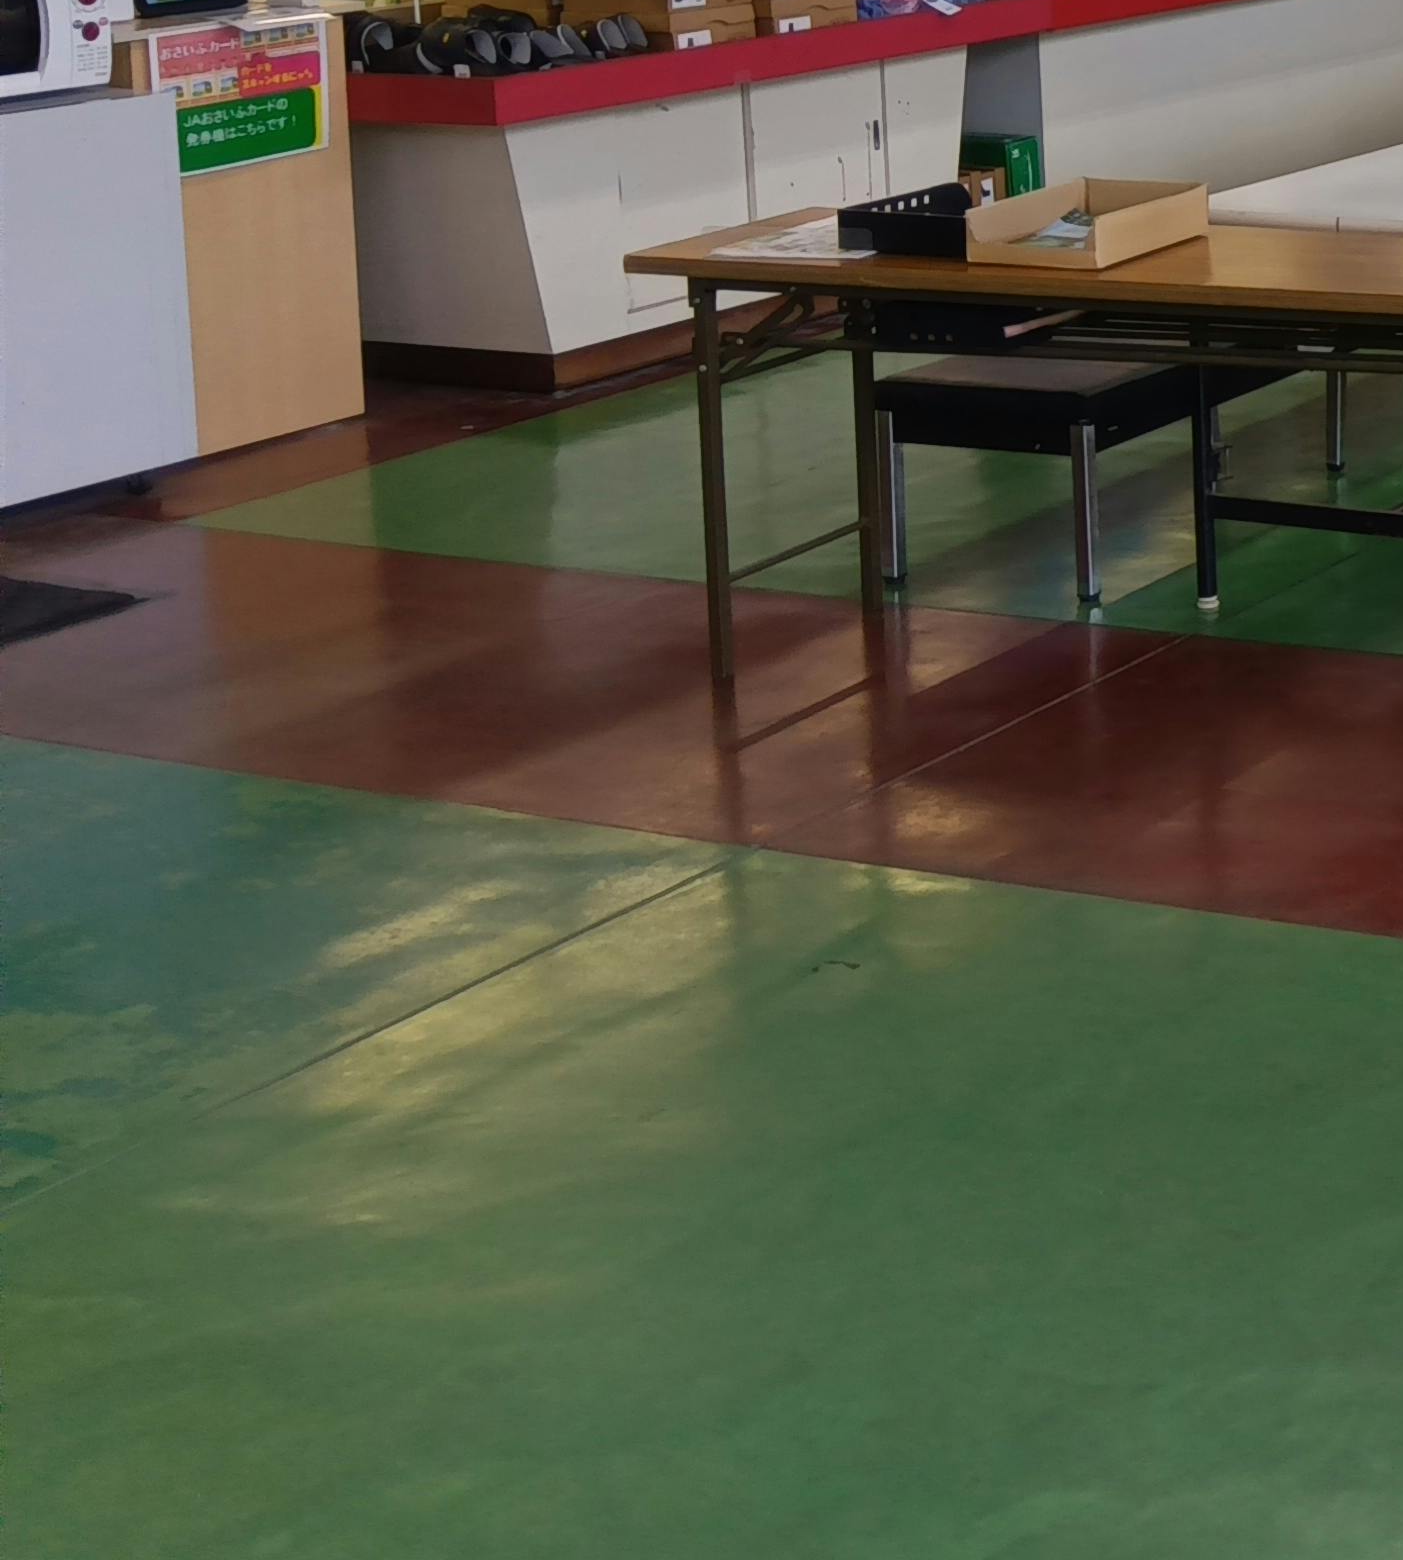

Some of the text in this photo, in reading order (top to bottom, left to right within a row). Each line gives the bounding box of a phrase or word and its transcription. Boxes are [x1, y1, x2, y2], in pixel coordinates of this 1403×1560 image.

[183, 97, 289, 128] JAおさいふカードの
